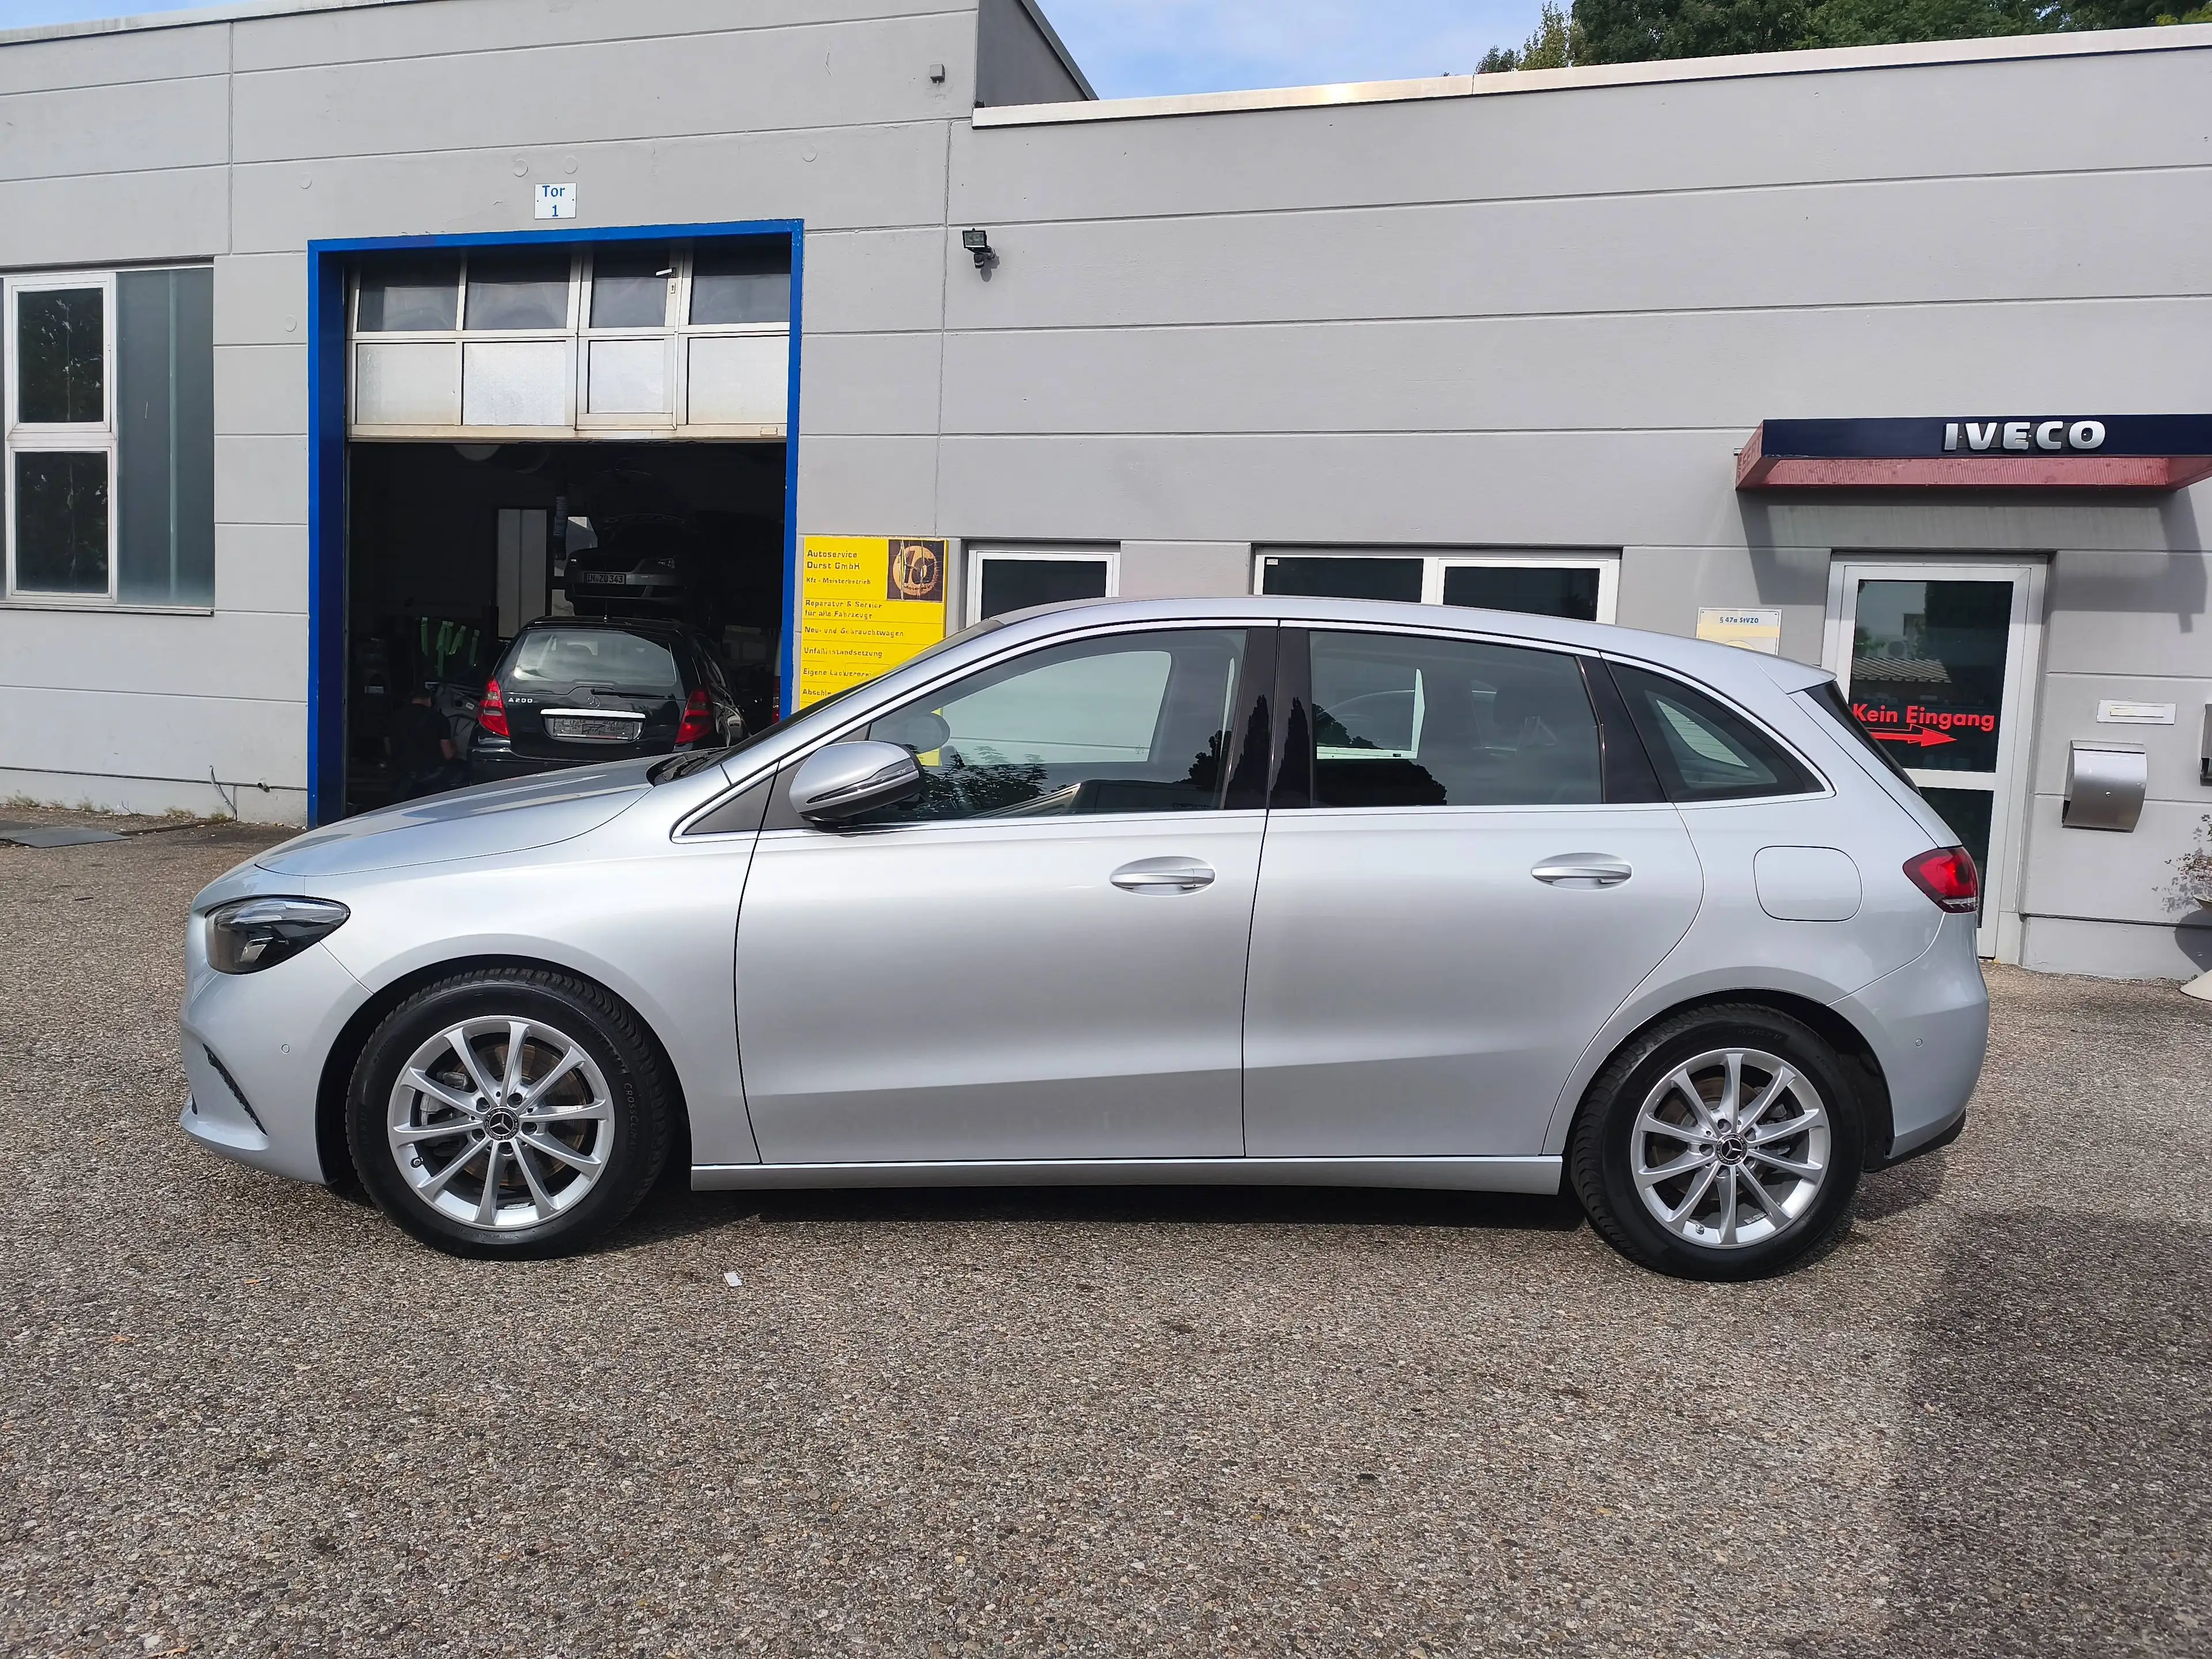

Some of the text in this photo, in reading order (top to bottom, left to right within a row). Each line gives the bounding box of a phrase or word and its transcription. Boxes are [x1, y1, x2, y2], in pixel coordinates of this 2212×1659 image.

[542, 185, 565, 197] Tor
[552, 204, 559, 217] 1
[1944, 421, 2106, 451] IVECO
[807, 550, 857, 558] Autoservice
[807, 561, 831, 569] Durst
[805, 600, 843, 608] Reparatur
[803, 668, 827, 676] Eigene
[1853, 703, 1995, 732] Kein Eingang
